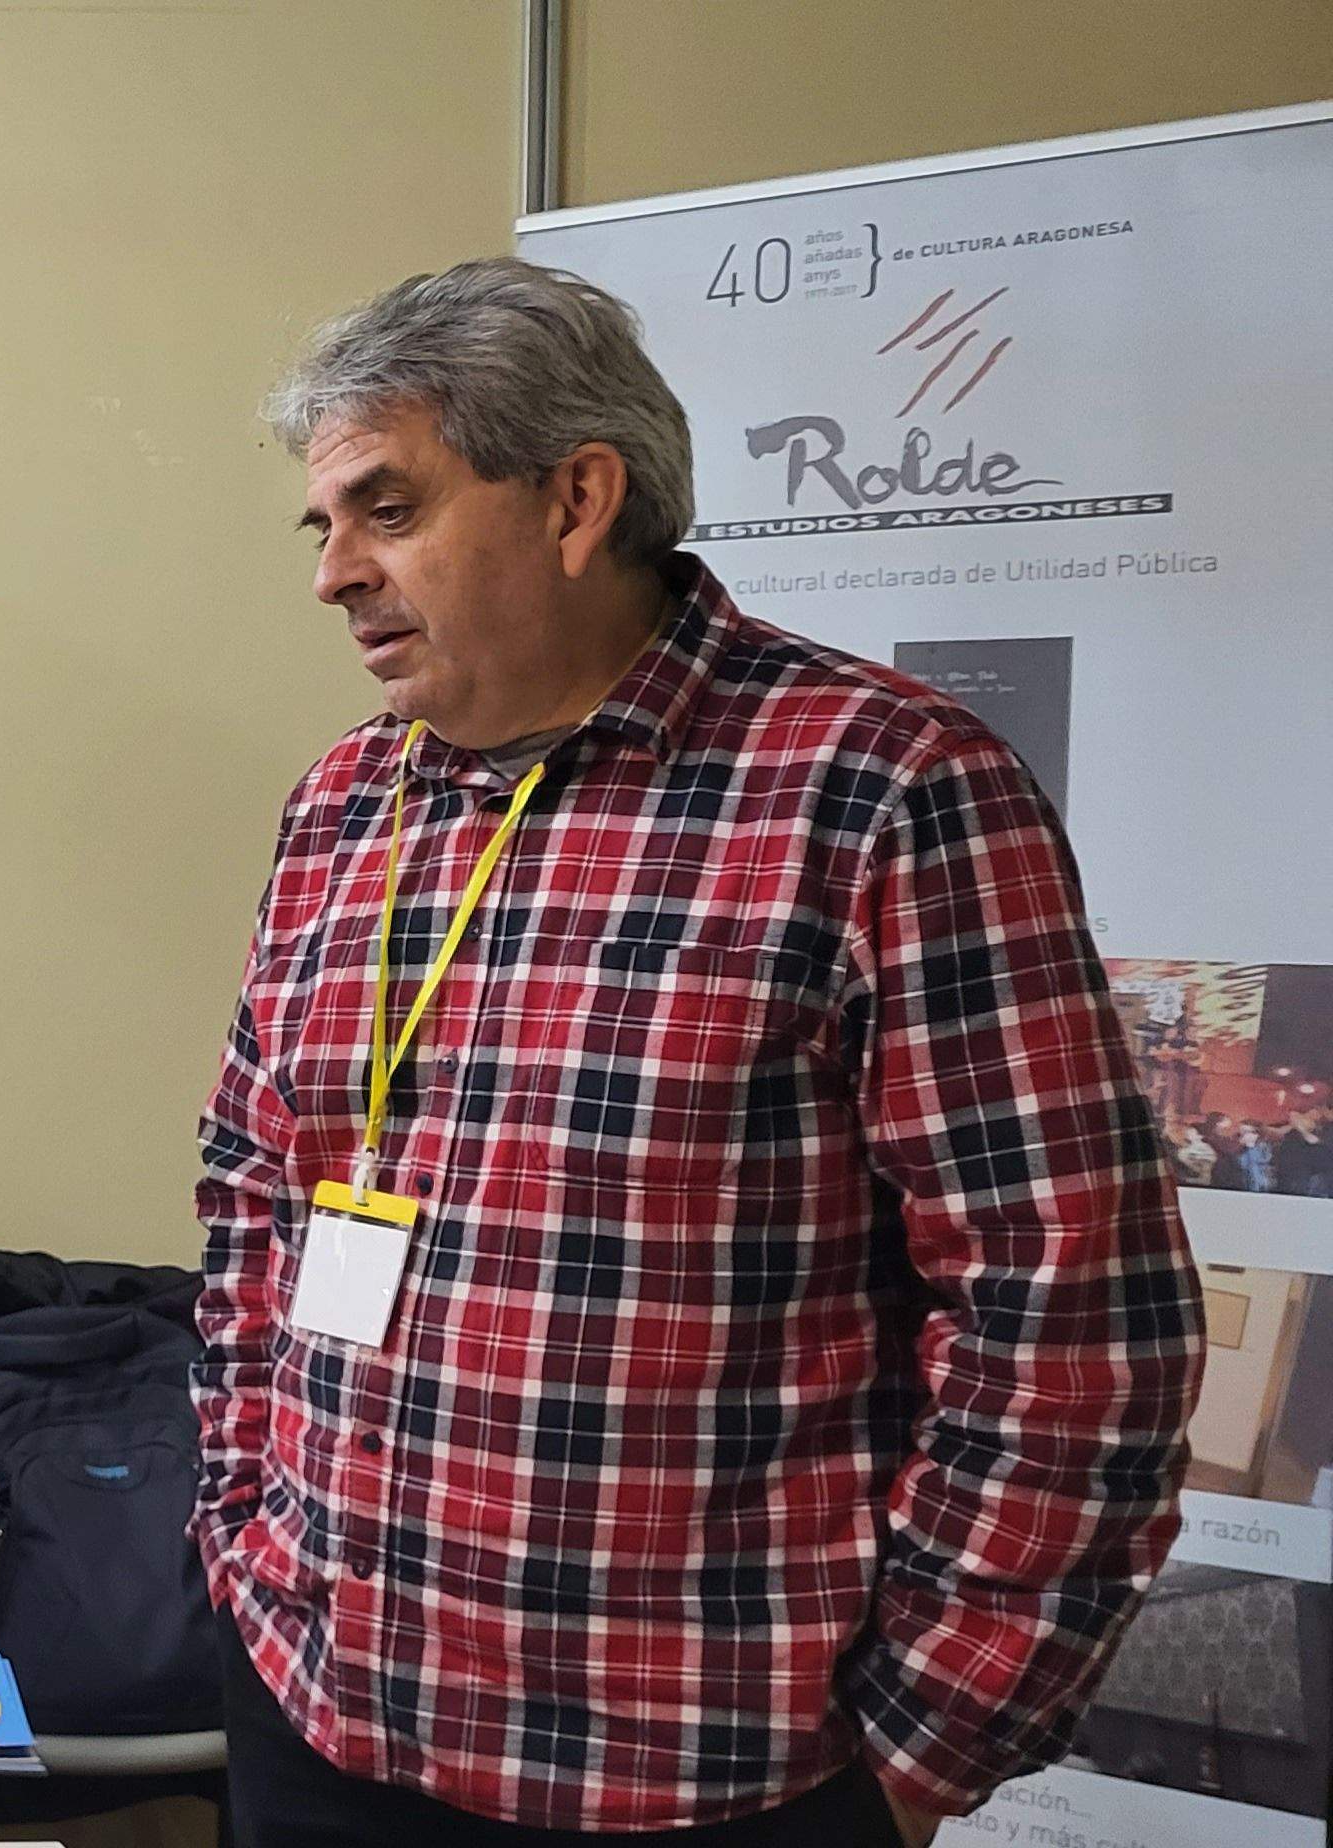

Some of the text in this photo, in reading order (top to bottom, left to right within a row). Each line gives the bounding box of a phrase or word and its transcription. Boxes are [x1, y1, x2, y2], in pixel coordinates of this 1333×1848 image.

[804, 229, 844, 245] años
[892, 220, 1134, 261] de CULTURA ARAGONESA
[706, 237, 792, 307] 40
[803, 246, 863, 264] añadas
[803, 268, 842, 285] anys
[745, 414, 1065, 508] Rolde
[708, 514, 881, 538] ESTUDIOS
[890, 496, 1166, 528] ARAGONESES
[735, 551, 1219, 596] cultural declarada de Utilidad Pública
[1202, 1518, 1280, 1547] razón
[1006, 1822, 1020, 1841] y
